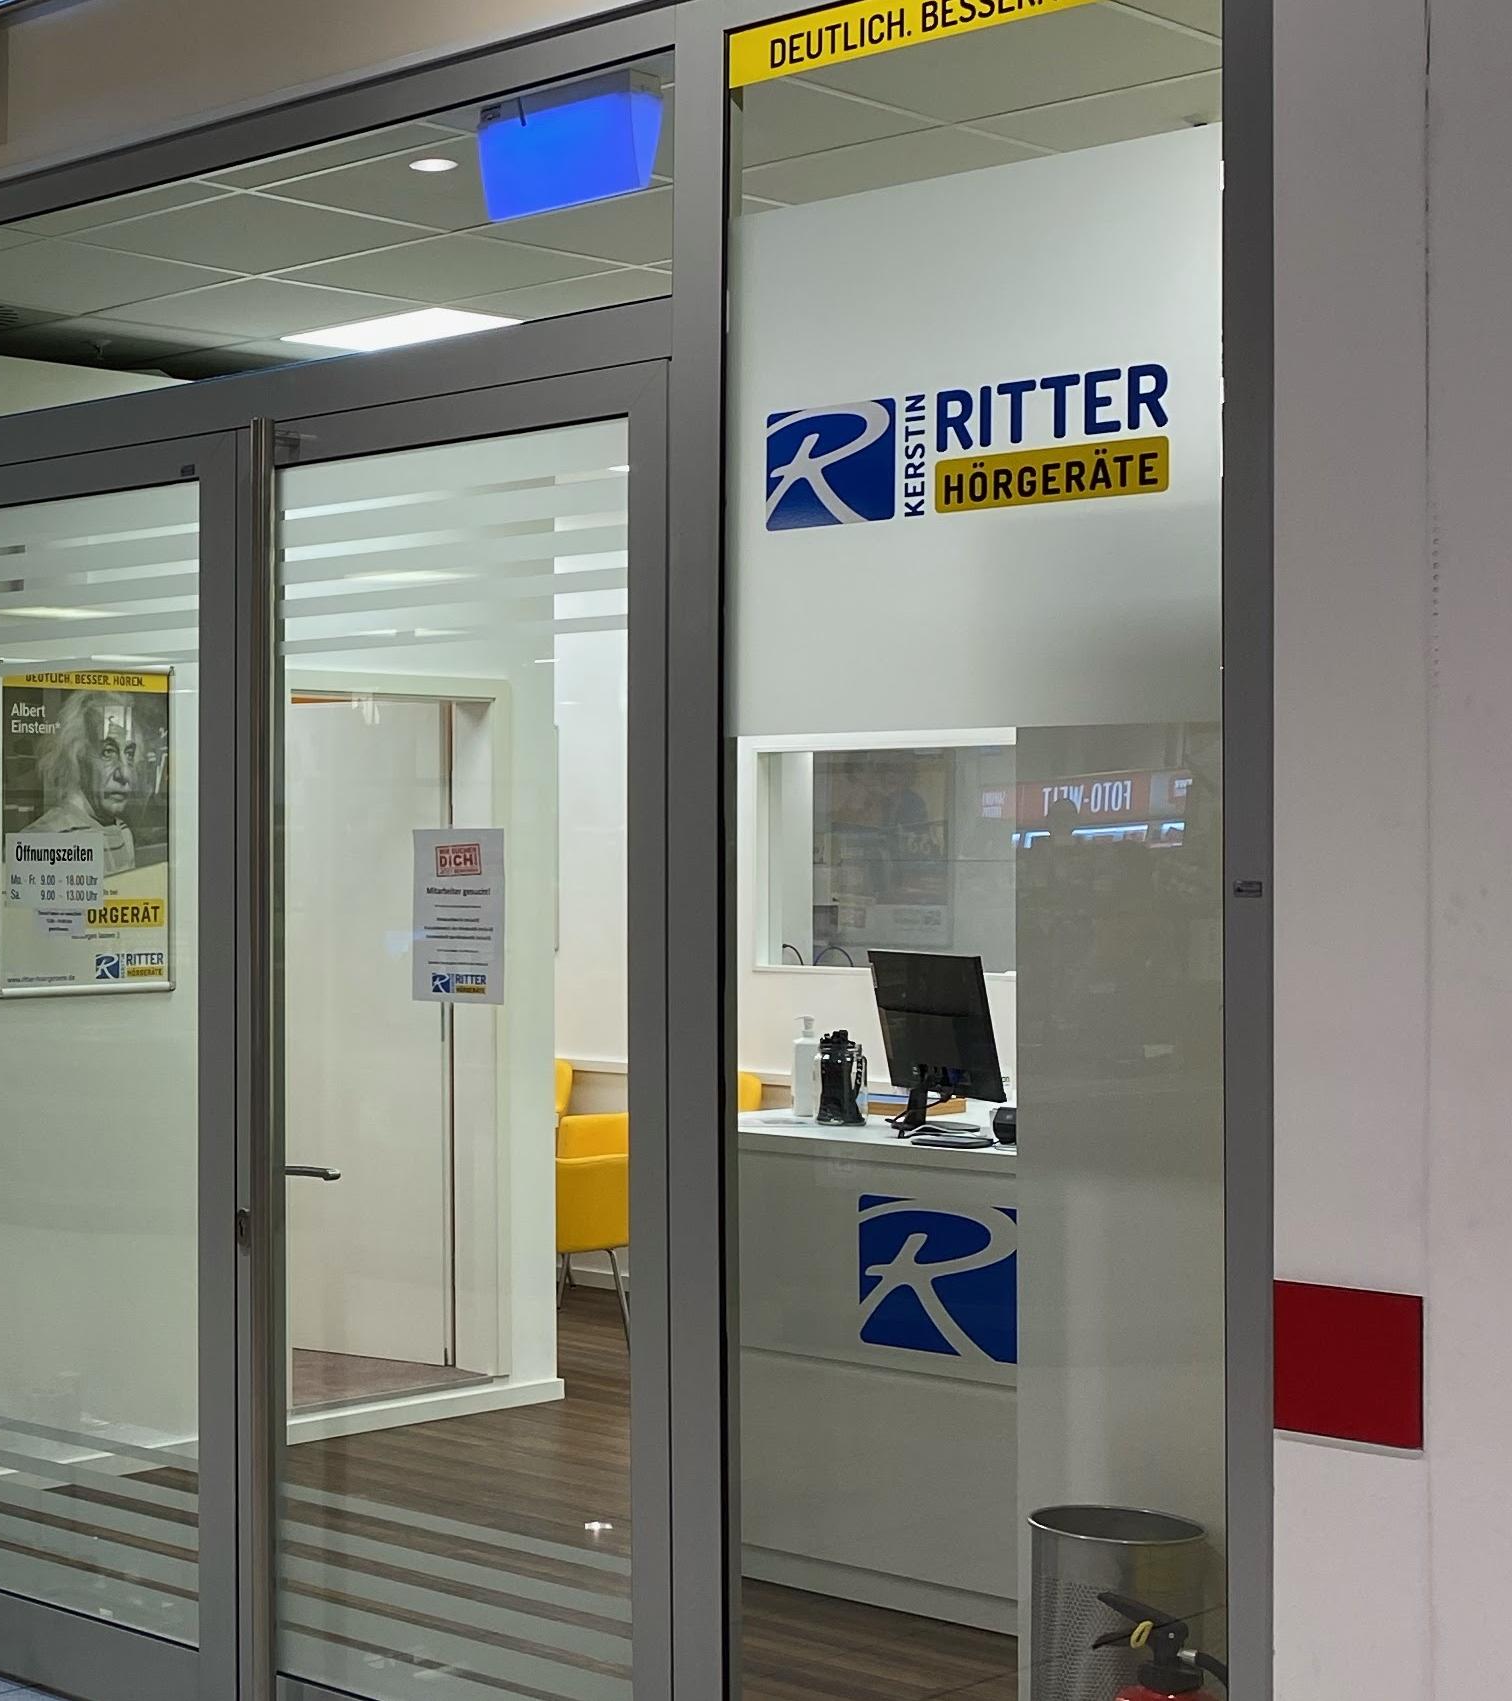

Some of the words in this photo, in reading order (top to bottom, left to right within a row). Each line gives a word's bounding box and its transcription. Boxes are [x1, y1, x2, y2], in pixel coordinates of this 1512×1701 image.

[769, 8, 913, 69] DEUTLICH.
[935, 363, 1169, 453] RITTER
[904, 393, 926, 518] KERSTIN
[944, 448, 1159, 506] HÖRGERÄTE
[75, 673, 111, 686] BESSER.
[10, 702, 45, 718] Albert
[15, 842, 94, 866] Öffnungszeiten
[439, 853, 478, 868] DICH!
[40, 875, 56, 886] 9.00
[65, 874, 85, 886] 18.00
[86, 874, 98, 886] Uhr
[40, 890, 56, 901] 9.00
[65, 890, 85, 901] 13.00
[86, 889, 98, 901] Uhr
[126, 953, 164, 965] RITTER
[455, 974, 487, 985] RITTER
